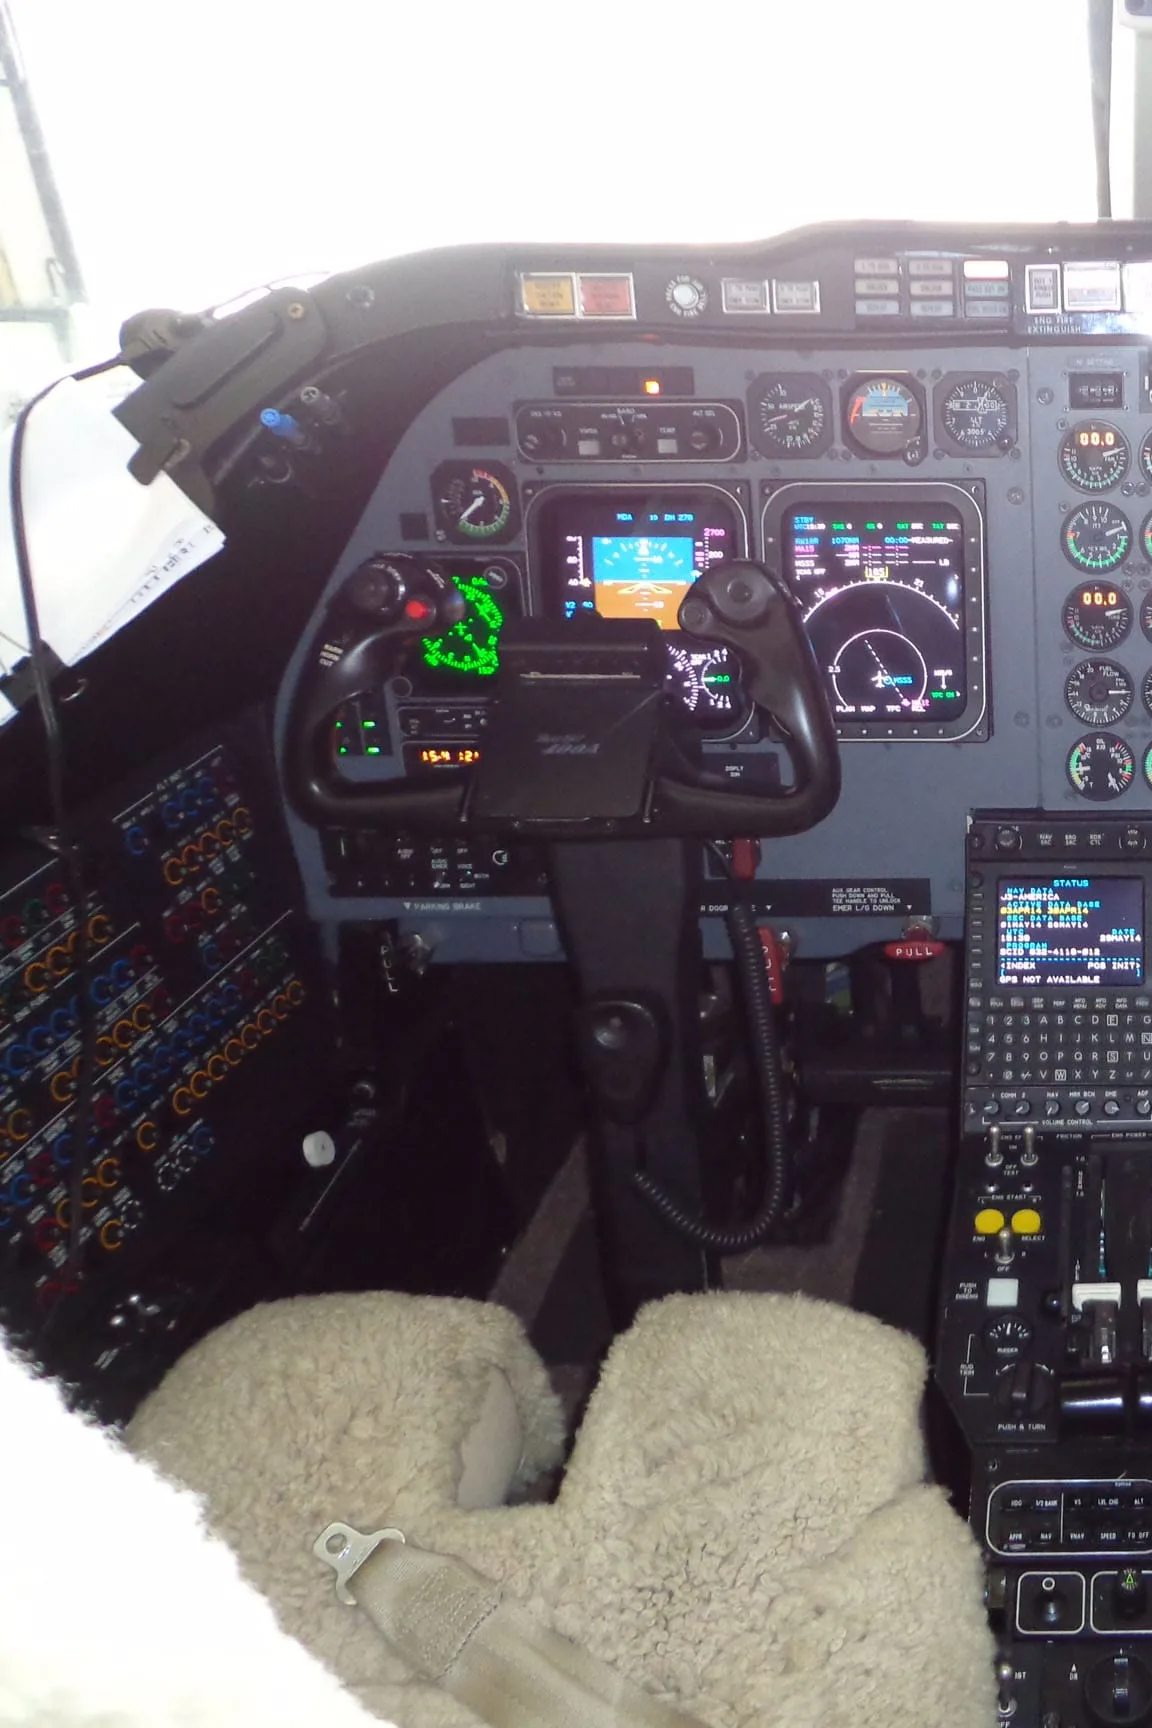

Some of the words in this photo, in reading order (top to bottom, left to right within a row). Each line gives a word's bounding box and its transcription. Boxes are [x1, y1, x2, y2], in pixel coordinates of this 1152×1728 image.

[1027, 326, 1082, 334] EXTINGUISH
[1079, 432, 1115, 446] 00.0
[704, 528, 725, 537] 2700
[1083, 592, 1117, 605] 00.0
[413, 903, 451, 911] PARKING
[453, 902, 481, 911] BRAKE
[832, 904, 853, 912] EMER
[855, 904, 870, 912] L/G
[872, 904, 895, 912] DOWN
[895, 947, 933, 957] PULL
[999, 976, 1018, 984] GPS
[1023, 976, 1041, 984] NOT
[1047, 976, 1100, 984] AVAILABLE
